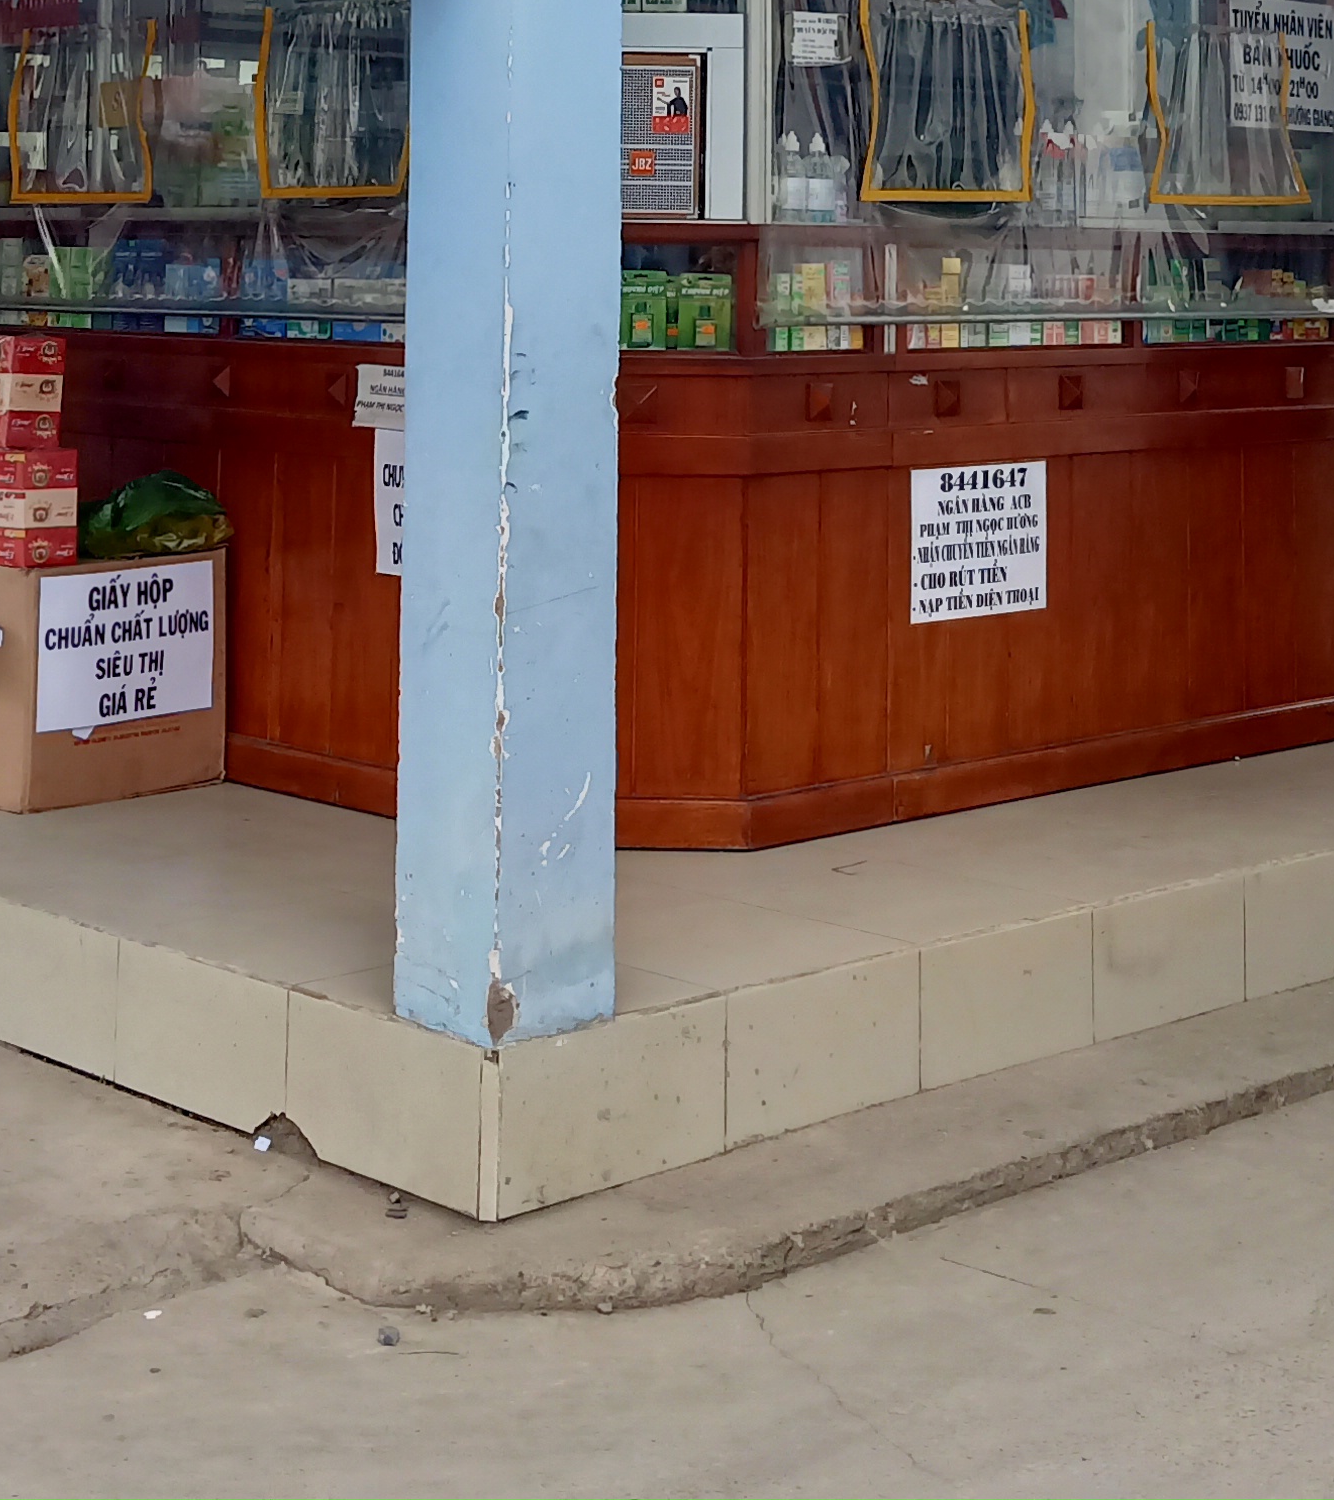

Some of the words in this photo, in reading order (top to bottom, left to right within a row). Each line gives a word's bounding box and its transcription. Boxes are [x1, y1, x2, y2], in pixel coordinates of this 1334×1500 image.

[1232, 1, 1270, 32] TUYỂN
[1273, 10, 1305, 38] NHÂN
[1307, 14, 1334, 40] VIÊN
[1278, 42, 1321, 72] HUỐC
[631, 157, 653, 171] JBZ
[940, 467, 1028, 493] 8441647
[937, 495, 969, 516] NGÂN
[971, 492, 1005, 514] HÀNG
[1010, 493, 1032, 511] ACB
[919, 522, 950, 540] PHẠM
[955, 519, 974, 537] THỊ
[975, 516, 1005, 536] NGỌC
[1006, 512, 1039, 531] HƯƠNG
[88, 574, 131, 611] GIẤY
[137, 573, 174, 609] HỘP
[920, 572, 946, 590] CHO
[948, 564, 976, 588] RÚT
[919, 597, 944, 618] NẠP
[1005, 586, 1039, 606] THOẠI
[45, 613, 106, 650] CHUẨN
[111, 610, 153, 644] CHẤT
[158, 609, 209, 638] LƯỢNG
[95, 651, 134, 680] SIÊU
[138, 650, 165, 676] THỊ
[99, 684, 128, 718] GIÁ
[134, 677, 157, 712] RẺ
